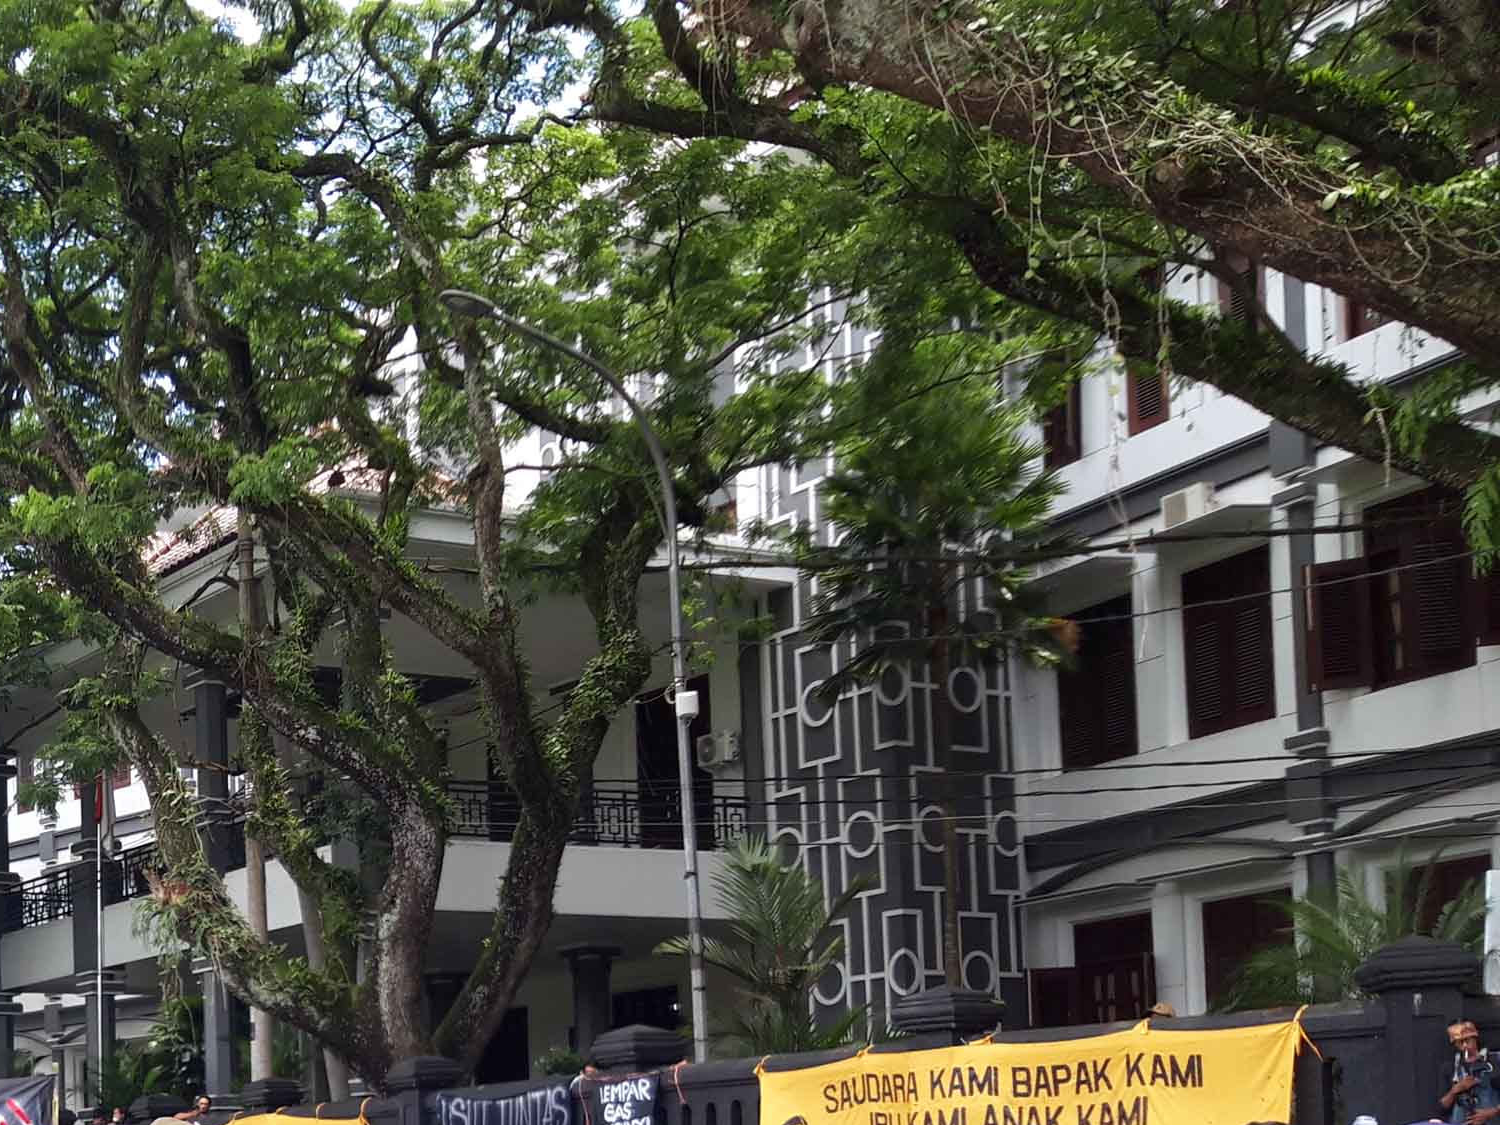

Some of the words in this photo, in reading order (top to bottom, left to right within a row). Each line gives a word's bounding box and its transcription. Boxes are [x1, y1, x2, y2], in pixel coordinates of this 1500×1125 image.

[823, 1071, 918, 1114] SAUDARA
[930, 1065, 999, 1100] KAMI
[1011, 1057, 1112, 1098] BAPAK
[1125, 1052, 1203, 1088] KAMI
[604, 1102, 632, 1123] GAS
